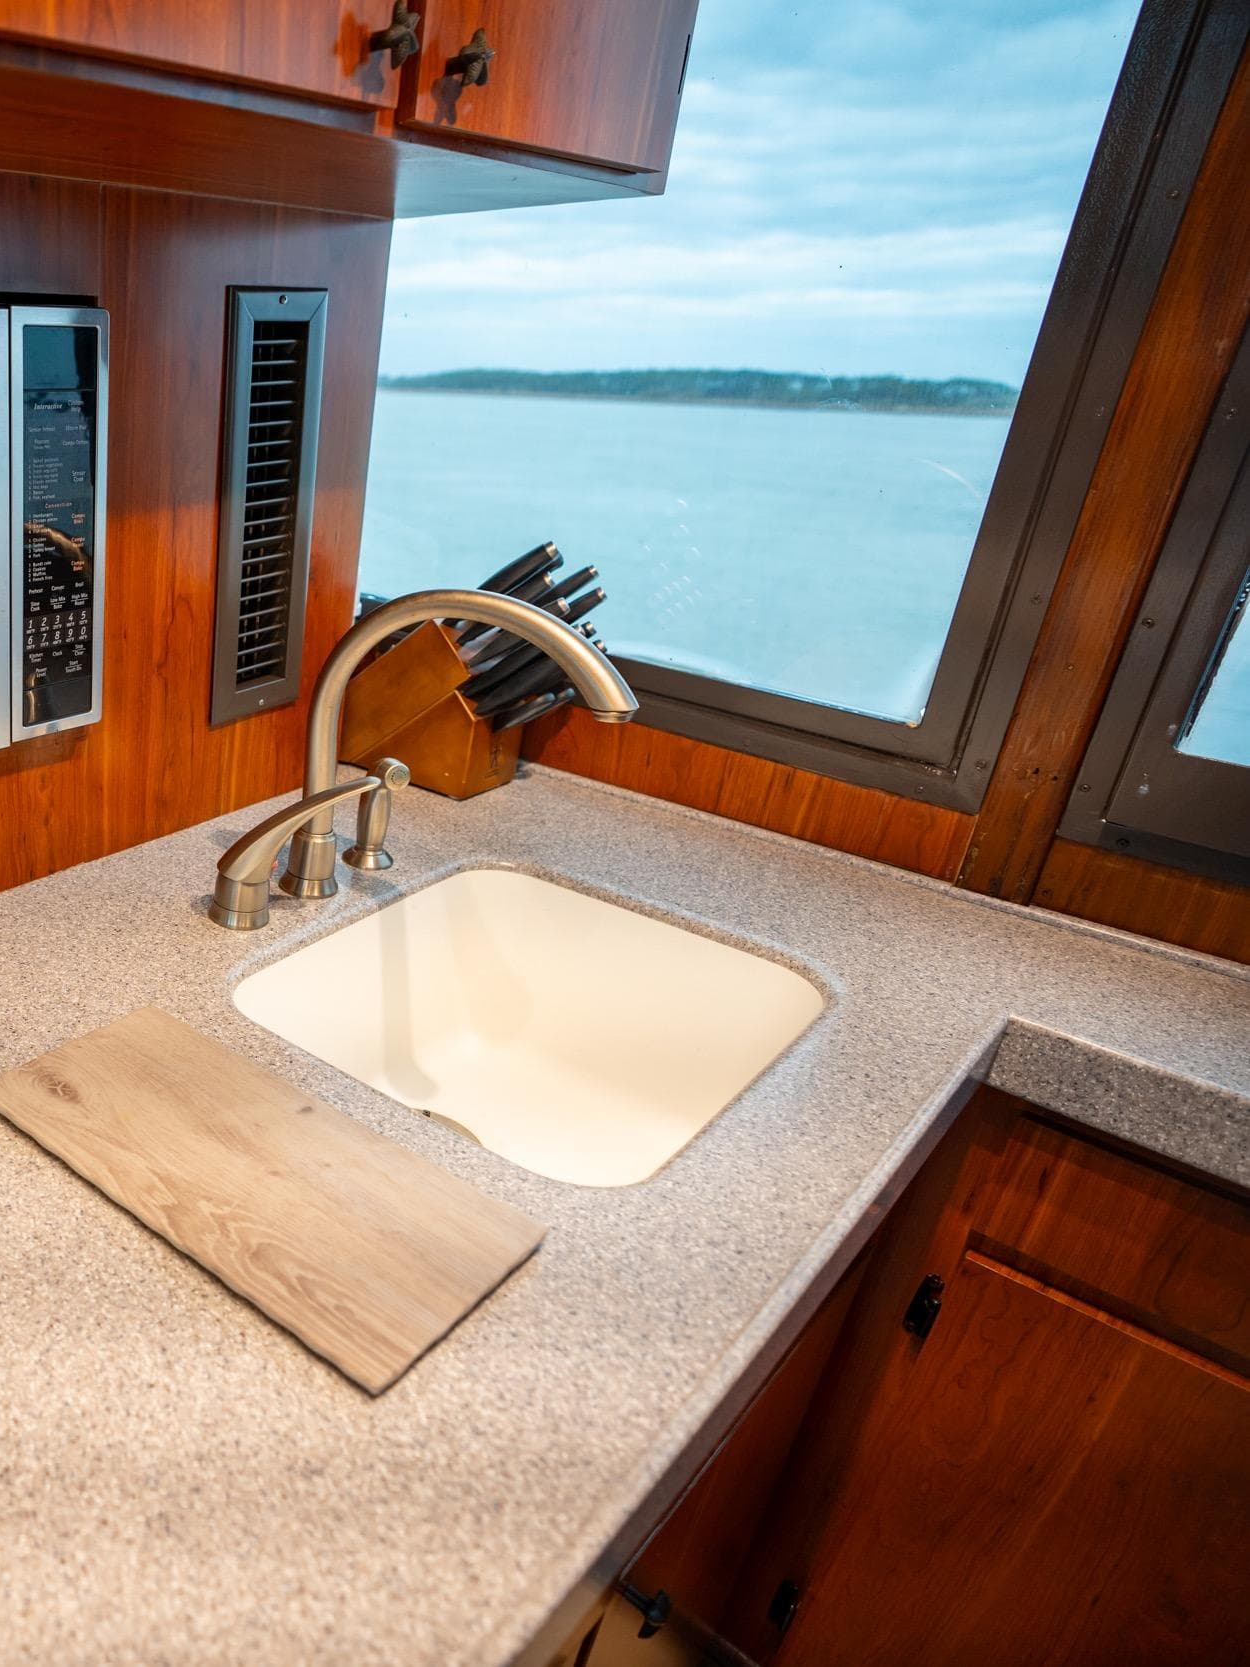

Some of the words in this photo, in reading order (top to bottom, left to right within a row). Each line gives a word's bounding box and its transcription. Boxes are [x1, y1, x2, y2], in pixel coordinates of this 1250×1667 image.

[42, 617, 47, 626] 2
[55, 615, 60, 624] 3
[68, 613, 73, 622] 4
[81, 611, 86, 620] 5
[28, 636, 33, 644] 6
[42, 634, 47, 642] 7
[55, 631, 60, 639] 8
[68, 629, 73, 637] 9
[81, 626, 86, 635] 0
